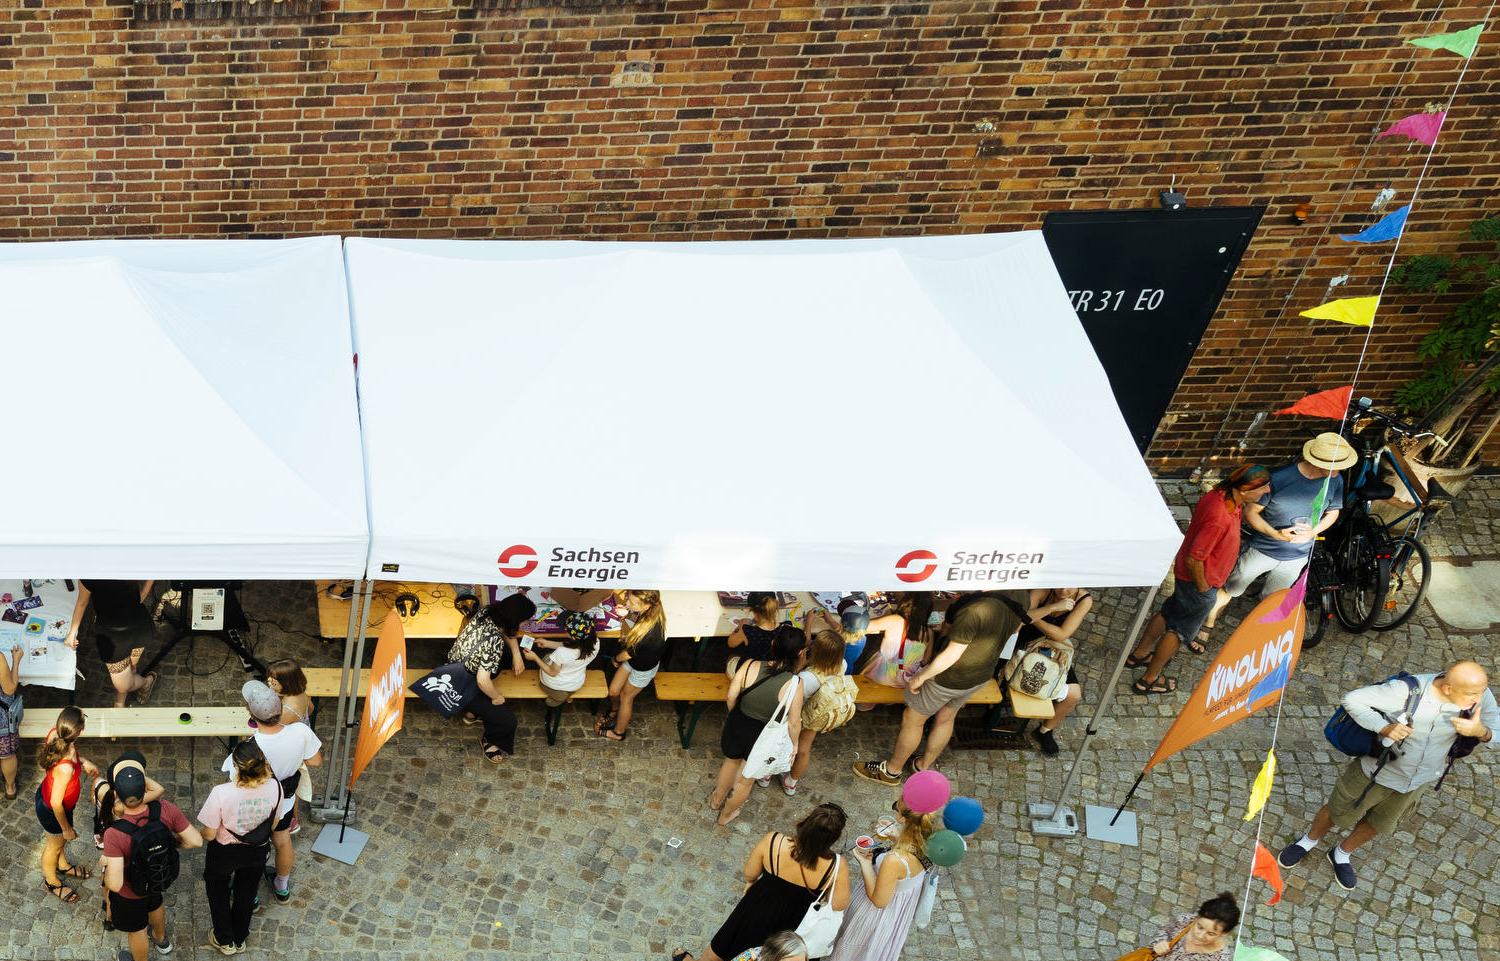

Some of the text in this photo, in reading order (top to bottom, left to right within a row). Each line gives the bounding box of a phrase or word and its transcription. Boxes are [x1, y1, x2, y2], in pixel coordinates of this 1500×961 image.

[1094, 290, 1126, 312] 31
[550, 547, 640, 563] Sachsen
[951, 550, 1045, 565] Sachsen
[547, 565, 629, 582] Energie
[946, 567, 1031, 583] Energie
[1205, 629, 1294, 708] KINOLINO
